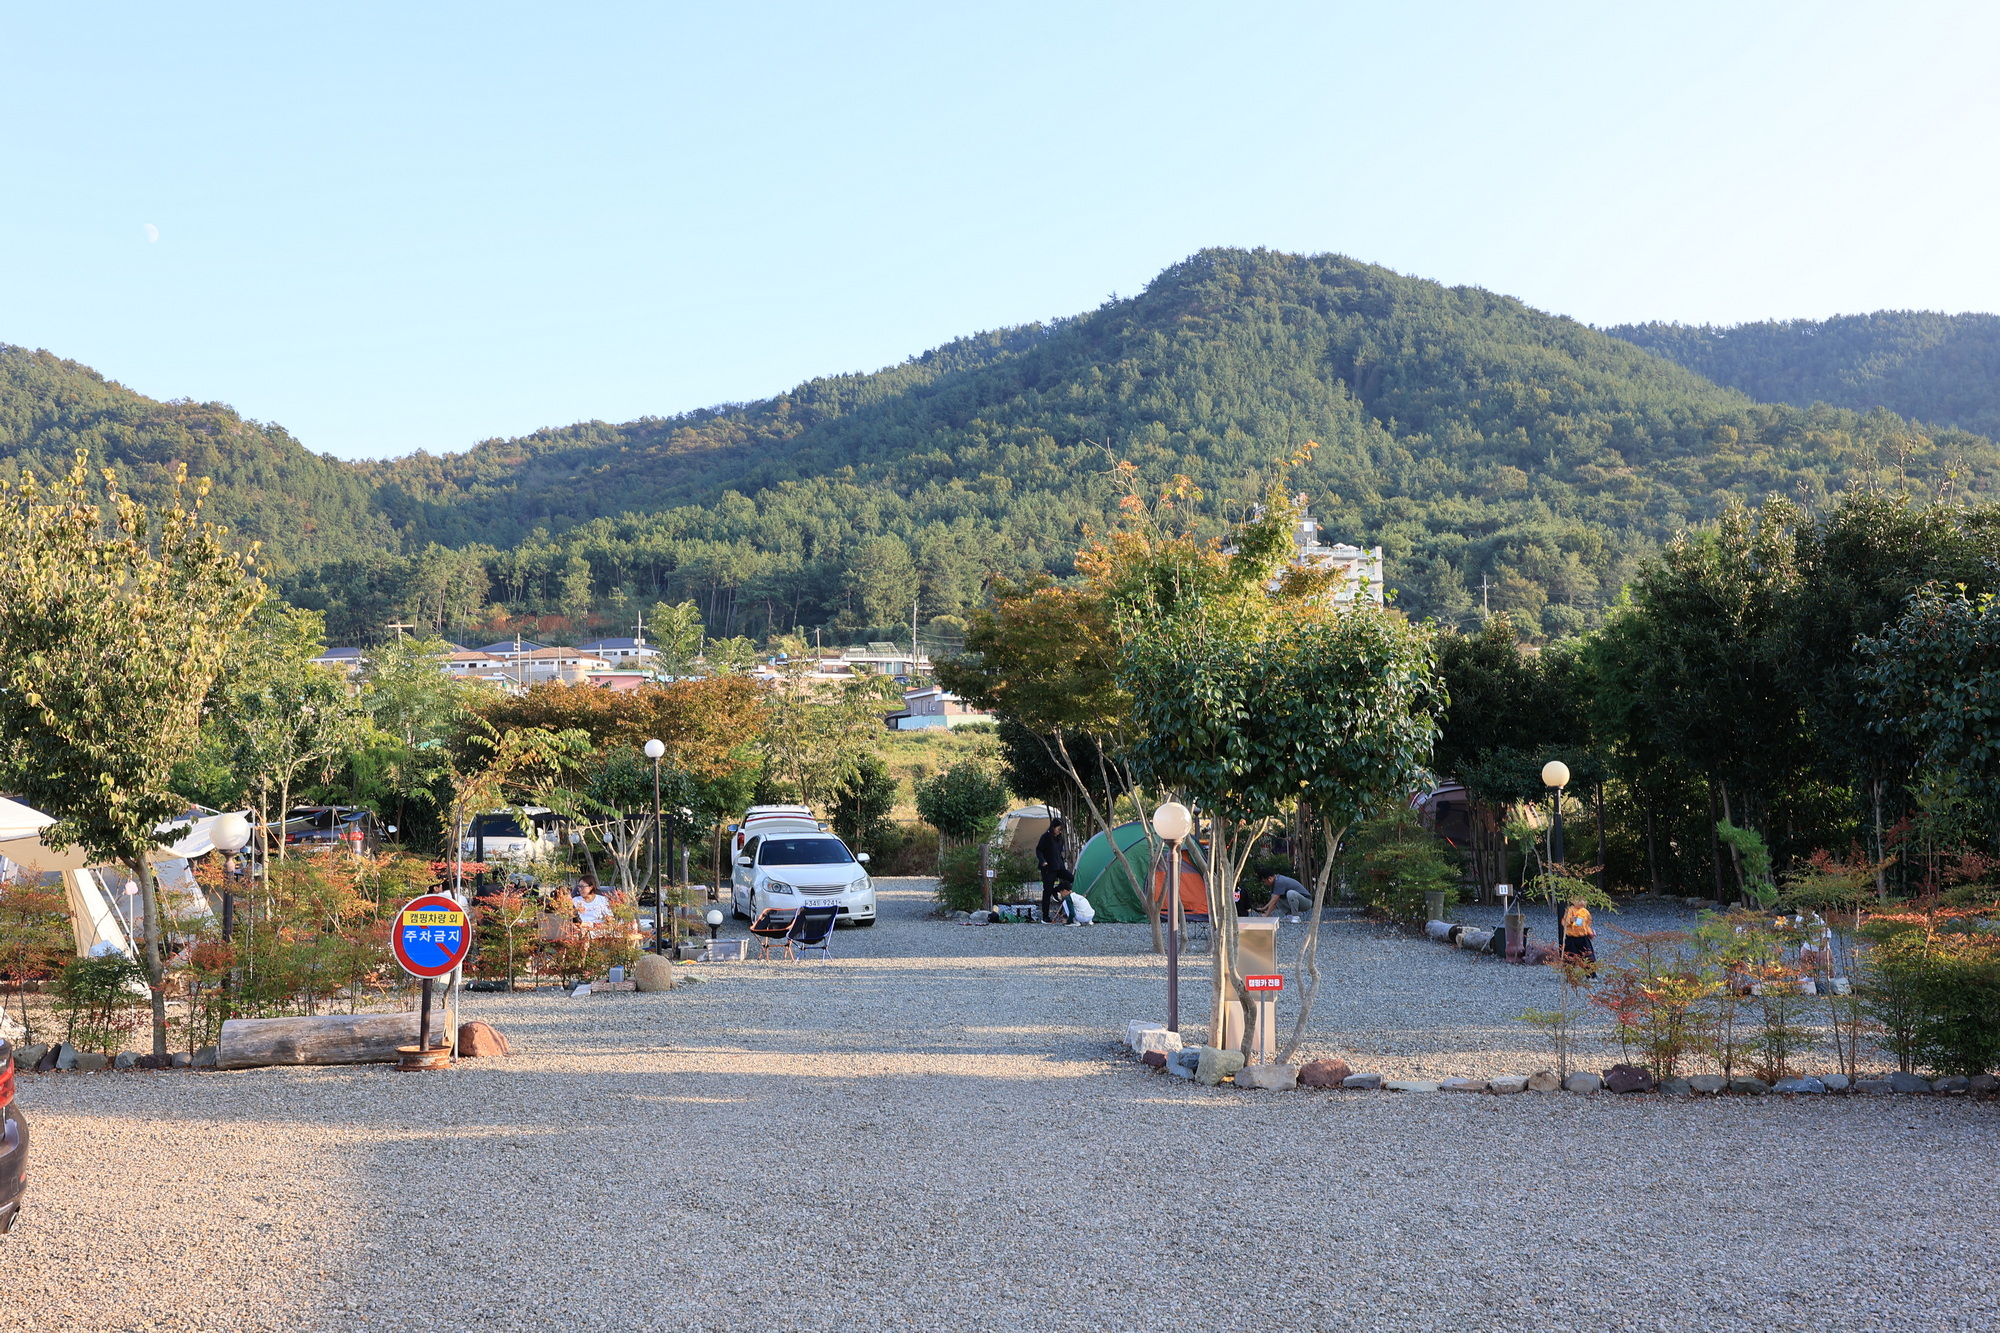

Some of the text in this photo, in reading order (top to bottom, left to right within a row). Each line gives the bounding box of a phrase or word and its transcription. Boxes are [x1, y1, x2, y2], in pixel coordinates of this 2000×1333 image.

[410, 913, 458, 924] 캠핑차량 외
[404, 929, 460, 943] 주차금지
[1267, 978, 1280, 987] 전용
